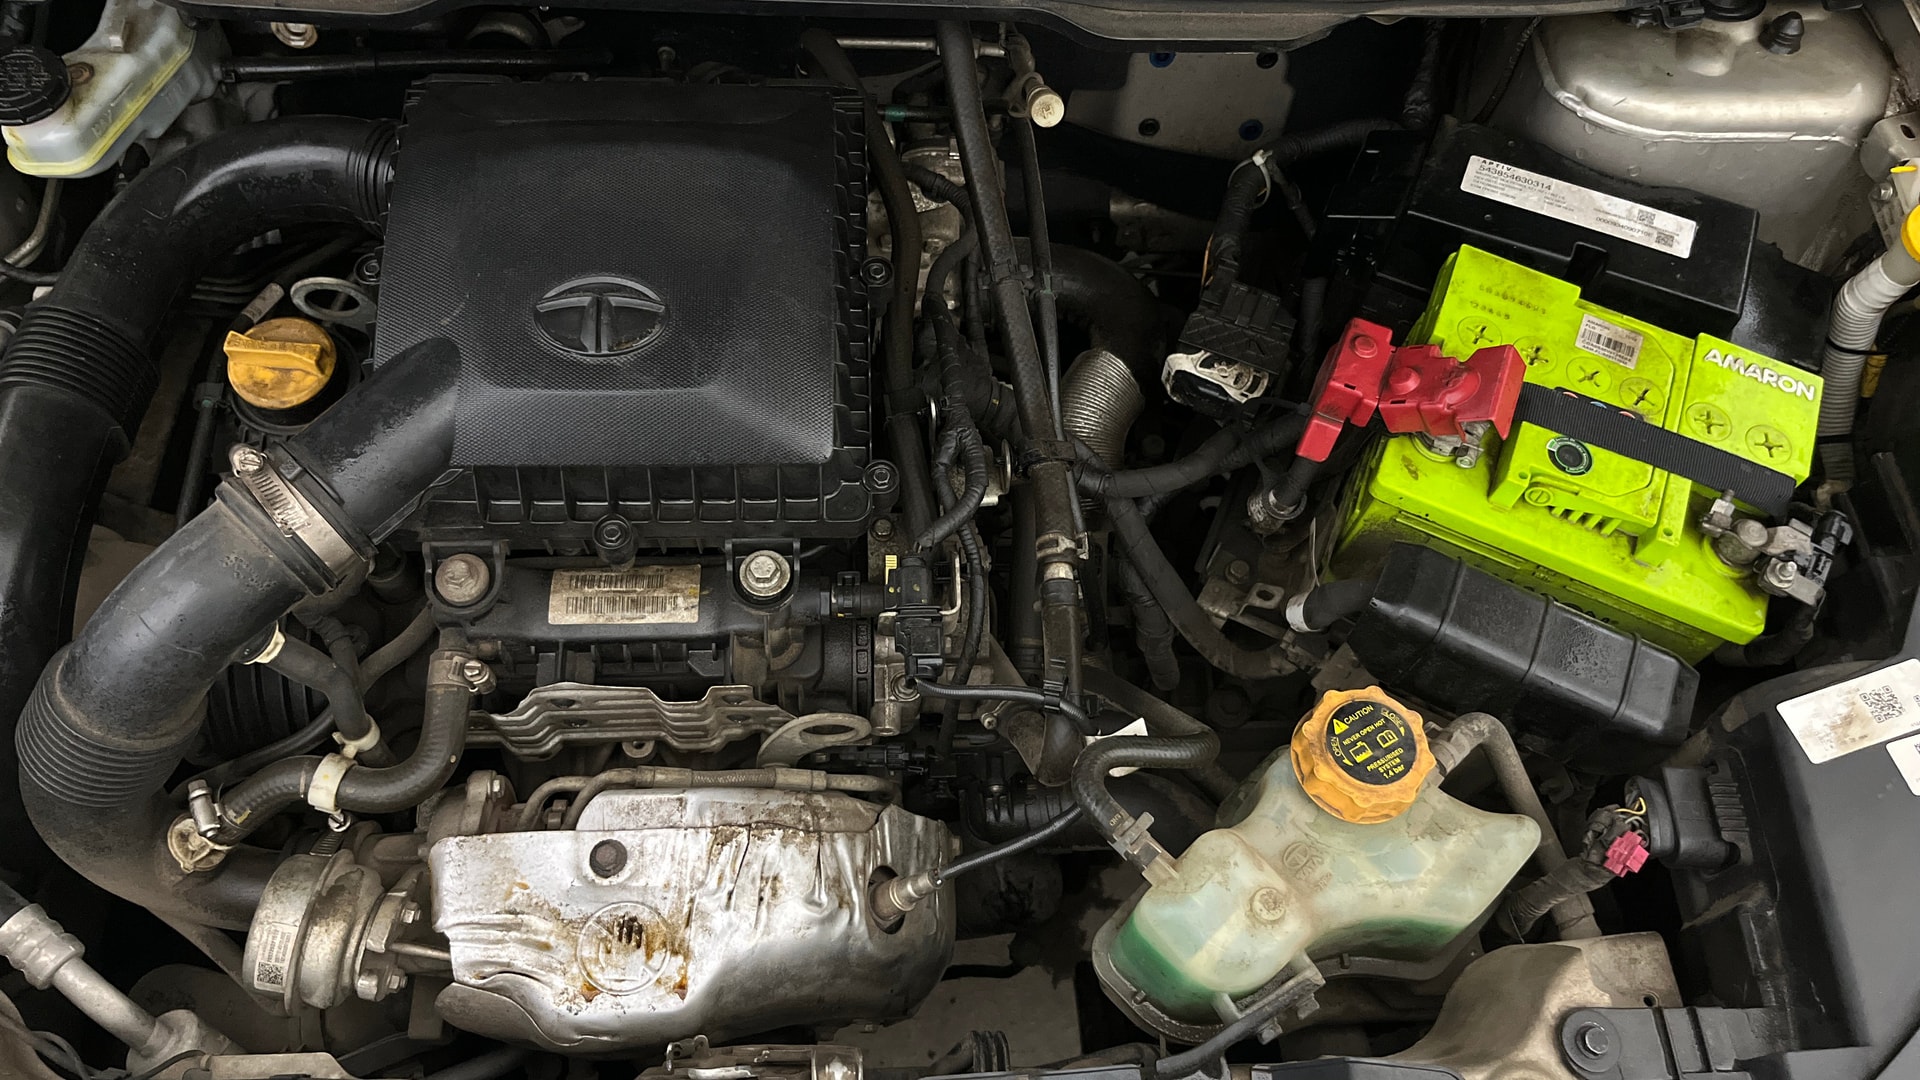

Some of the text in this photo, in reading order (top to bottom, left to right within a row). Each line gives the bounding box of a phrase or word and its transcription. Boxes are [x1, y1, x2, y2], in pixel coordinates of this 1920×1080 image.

[1481, 159, 1512, 172] APTIV
[1478, 164, 1552, 191] 543854630314
[1703, 348, 1816, 402] AMARON
[1343, 704, 1375, 725] CAUTION
[1342, 717, 1386, 746] NEVER OPEN HOT
[1330, 736, 1341, 757] OPEN
[1366, 747, 1404, 772] PRESSURISED
[1378, 757, 1401, 773] SYSTEM
[1392, 764, 1405, 774] bar
